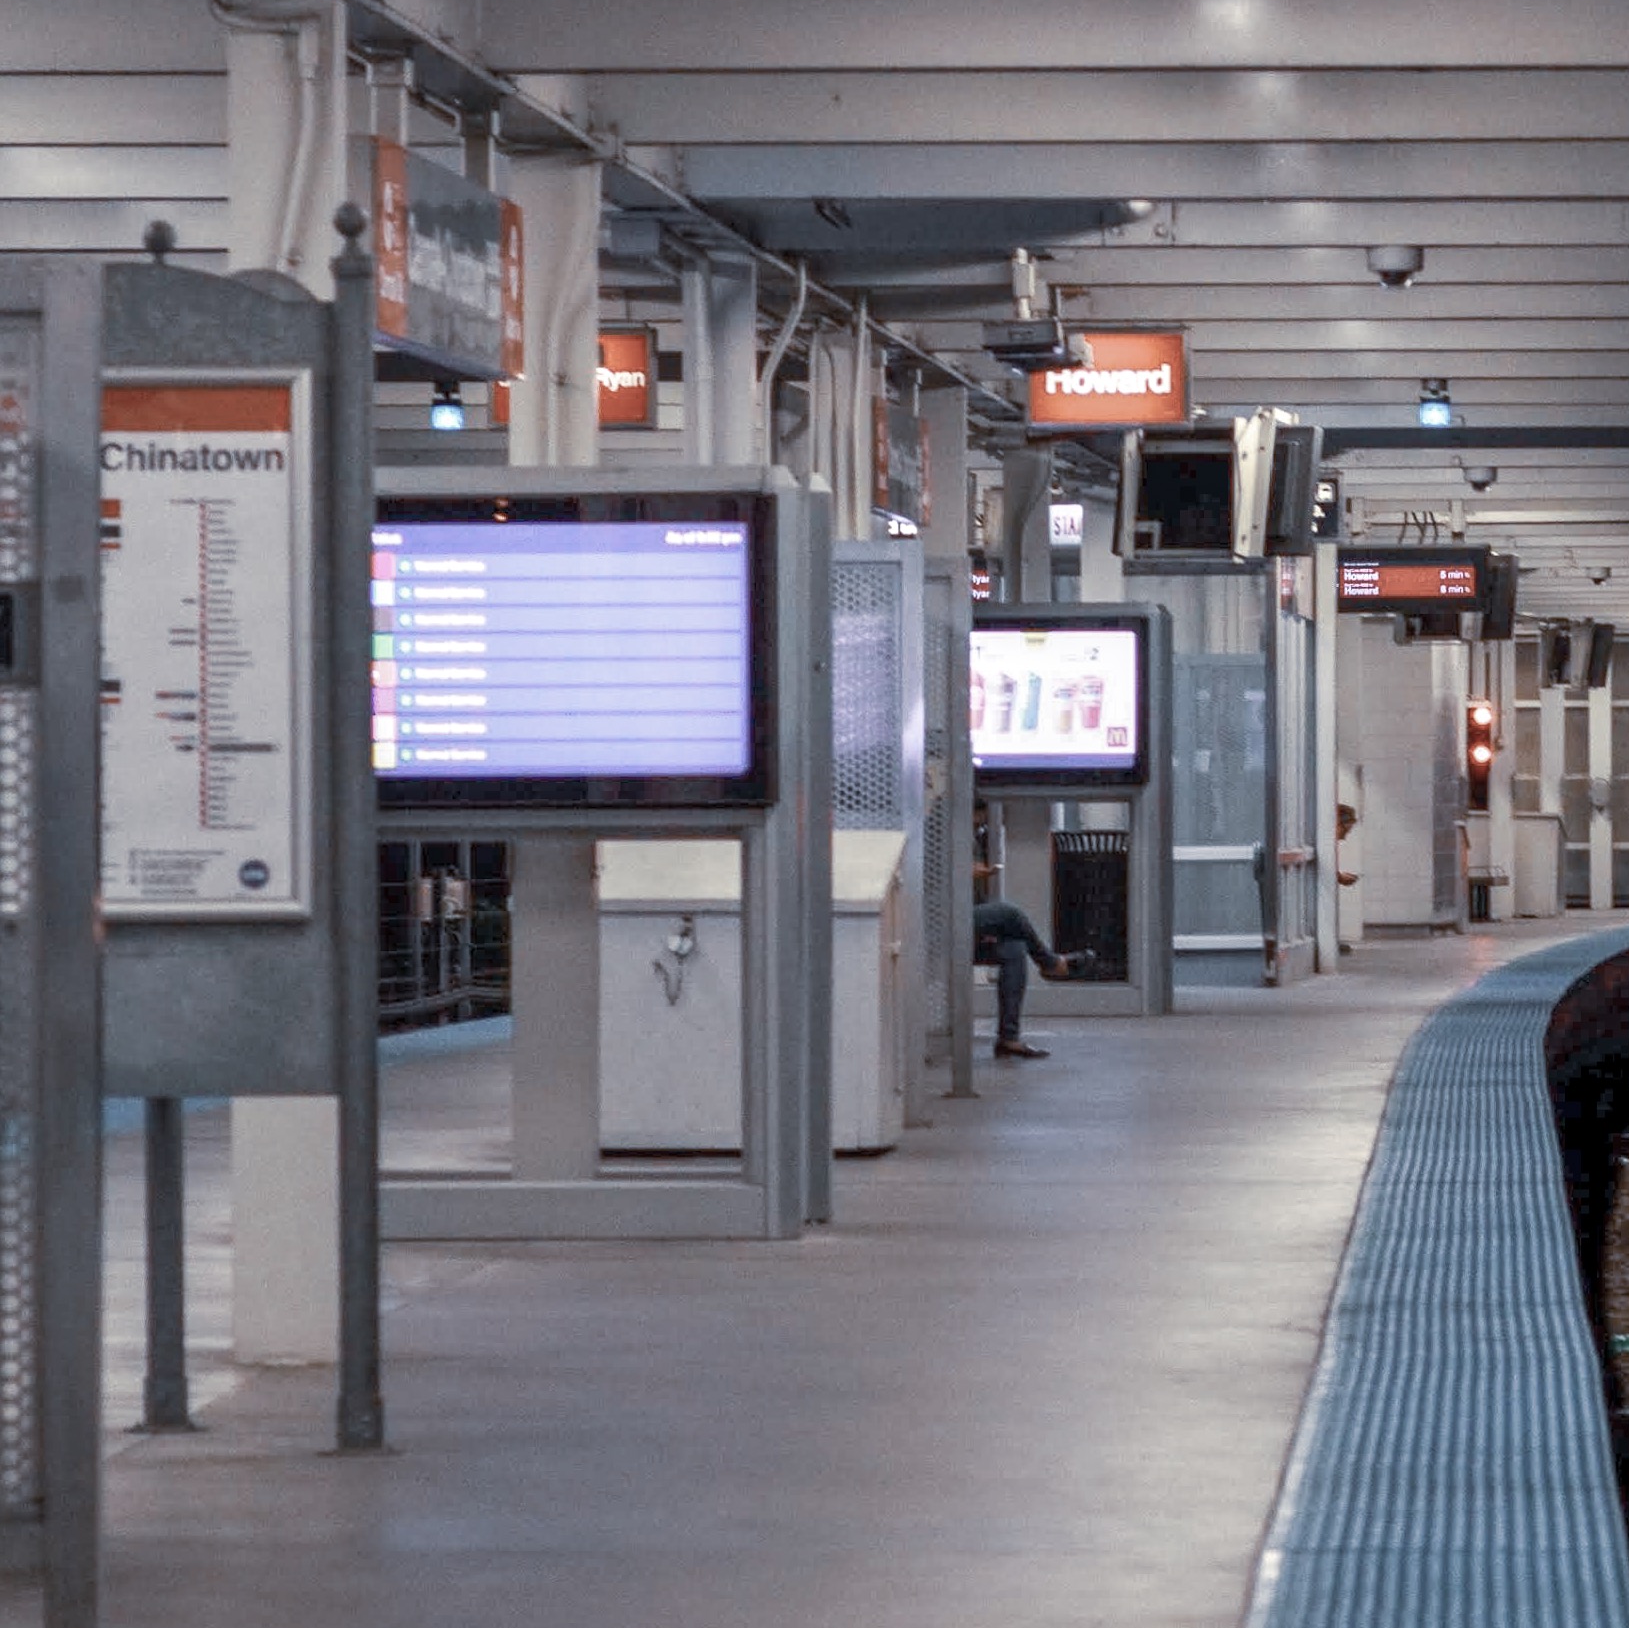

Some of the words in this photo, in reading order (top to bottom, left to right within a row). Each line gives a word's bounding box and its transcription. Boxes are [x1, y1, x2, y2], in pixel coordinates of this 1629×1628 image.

[1045, 363, 1171, 395] Howard
[100, 442, 285, 471] Chinatown
[1053, 516, 1081, 536] STA
[1343, 571, 1379, 581] Howard
[1448, 570, 1464, 579] min
[1343, 586, 1379, 596] Howard
[1448, 584, 1464, 594] min
